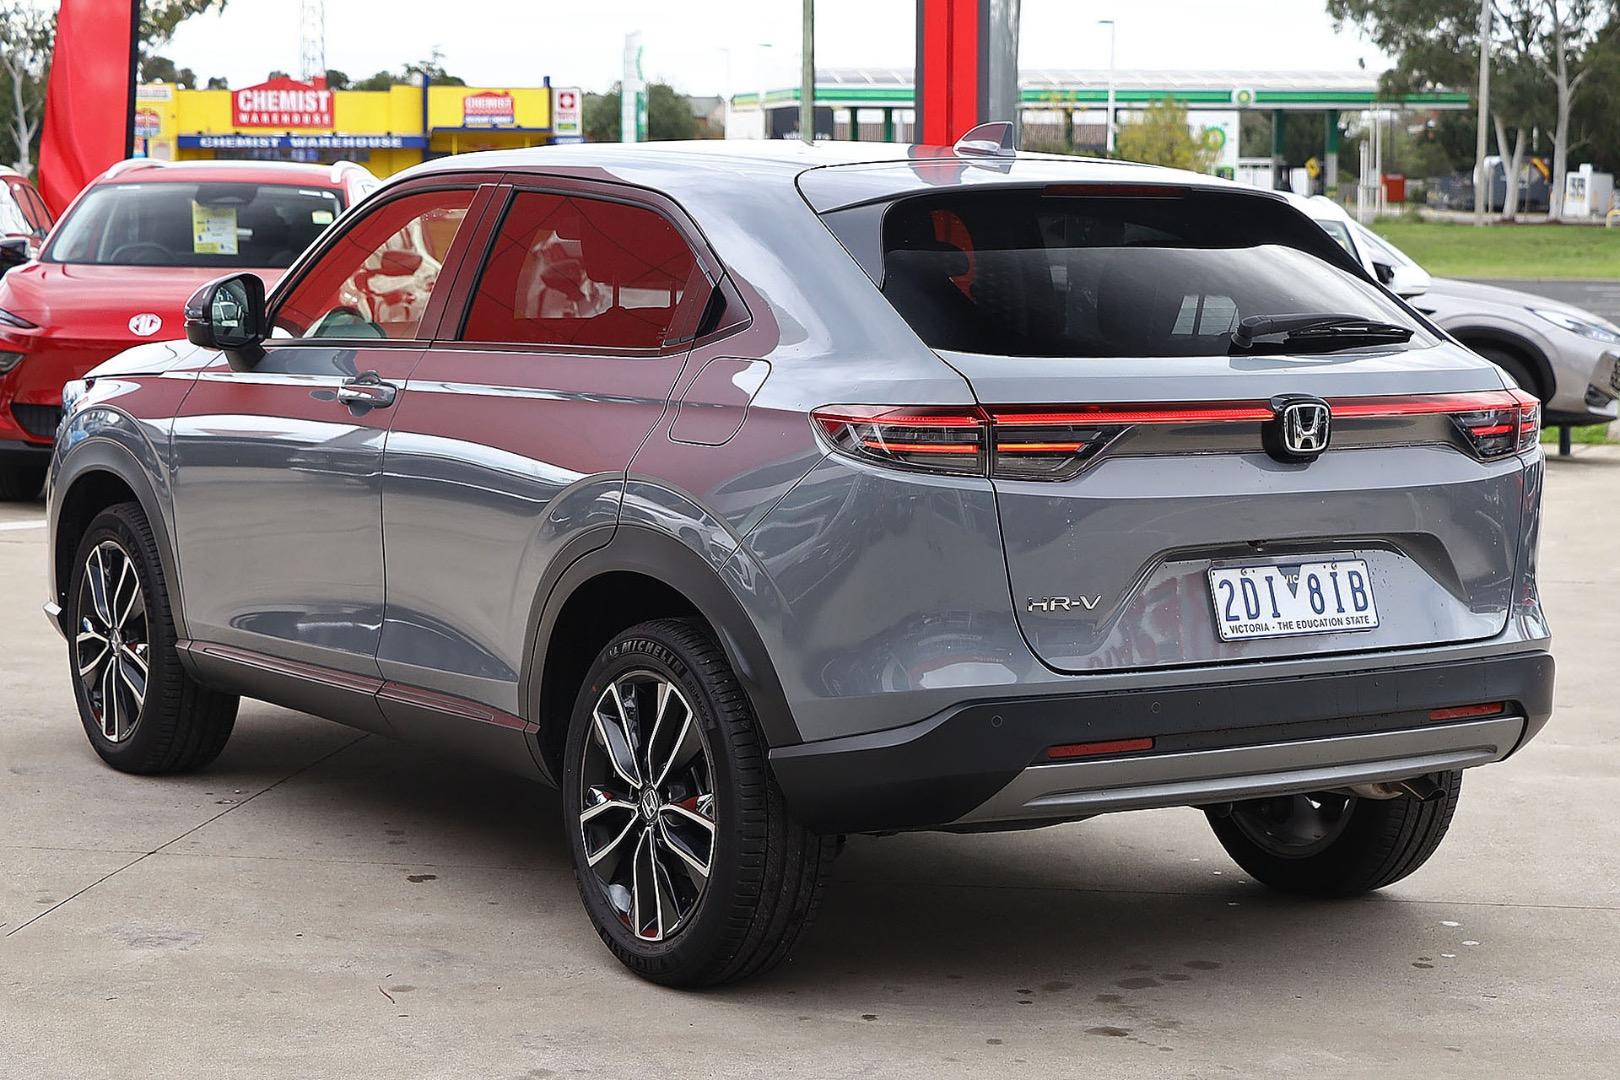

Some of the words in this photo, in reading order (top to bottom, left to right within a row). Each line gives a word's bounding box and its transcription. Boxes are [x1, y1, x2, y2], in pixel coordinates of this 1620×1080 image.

[238, 91, 330, 112] CHEMIST
[238, 113, 331, 125] WAREHOUSE
[200, 137, 281, 148] CHEMIST
[289, 137, 402, 148] WAREHOUSE
[131, 314, 161, 335] MG
[1284, 574, 1299, 584] VIC
[1028, 594, 1101, 611] HR-V
[1219, 575, 1281, 621] 2DI
[1308, 570, 1369, 614] 8IB
[1229, 622, 1270, 634] VICTORIA
[1278, 621, 1294, 630] THE
[1296, 617, 1343, 628] EDUCATION
[1345, 615, 1370, 625] STATE
[621, 640, 685, 675] MICHELIN
